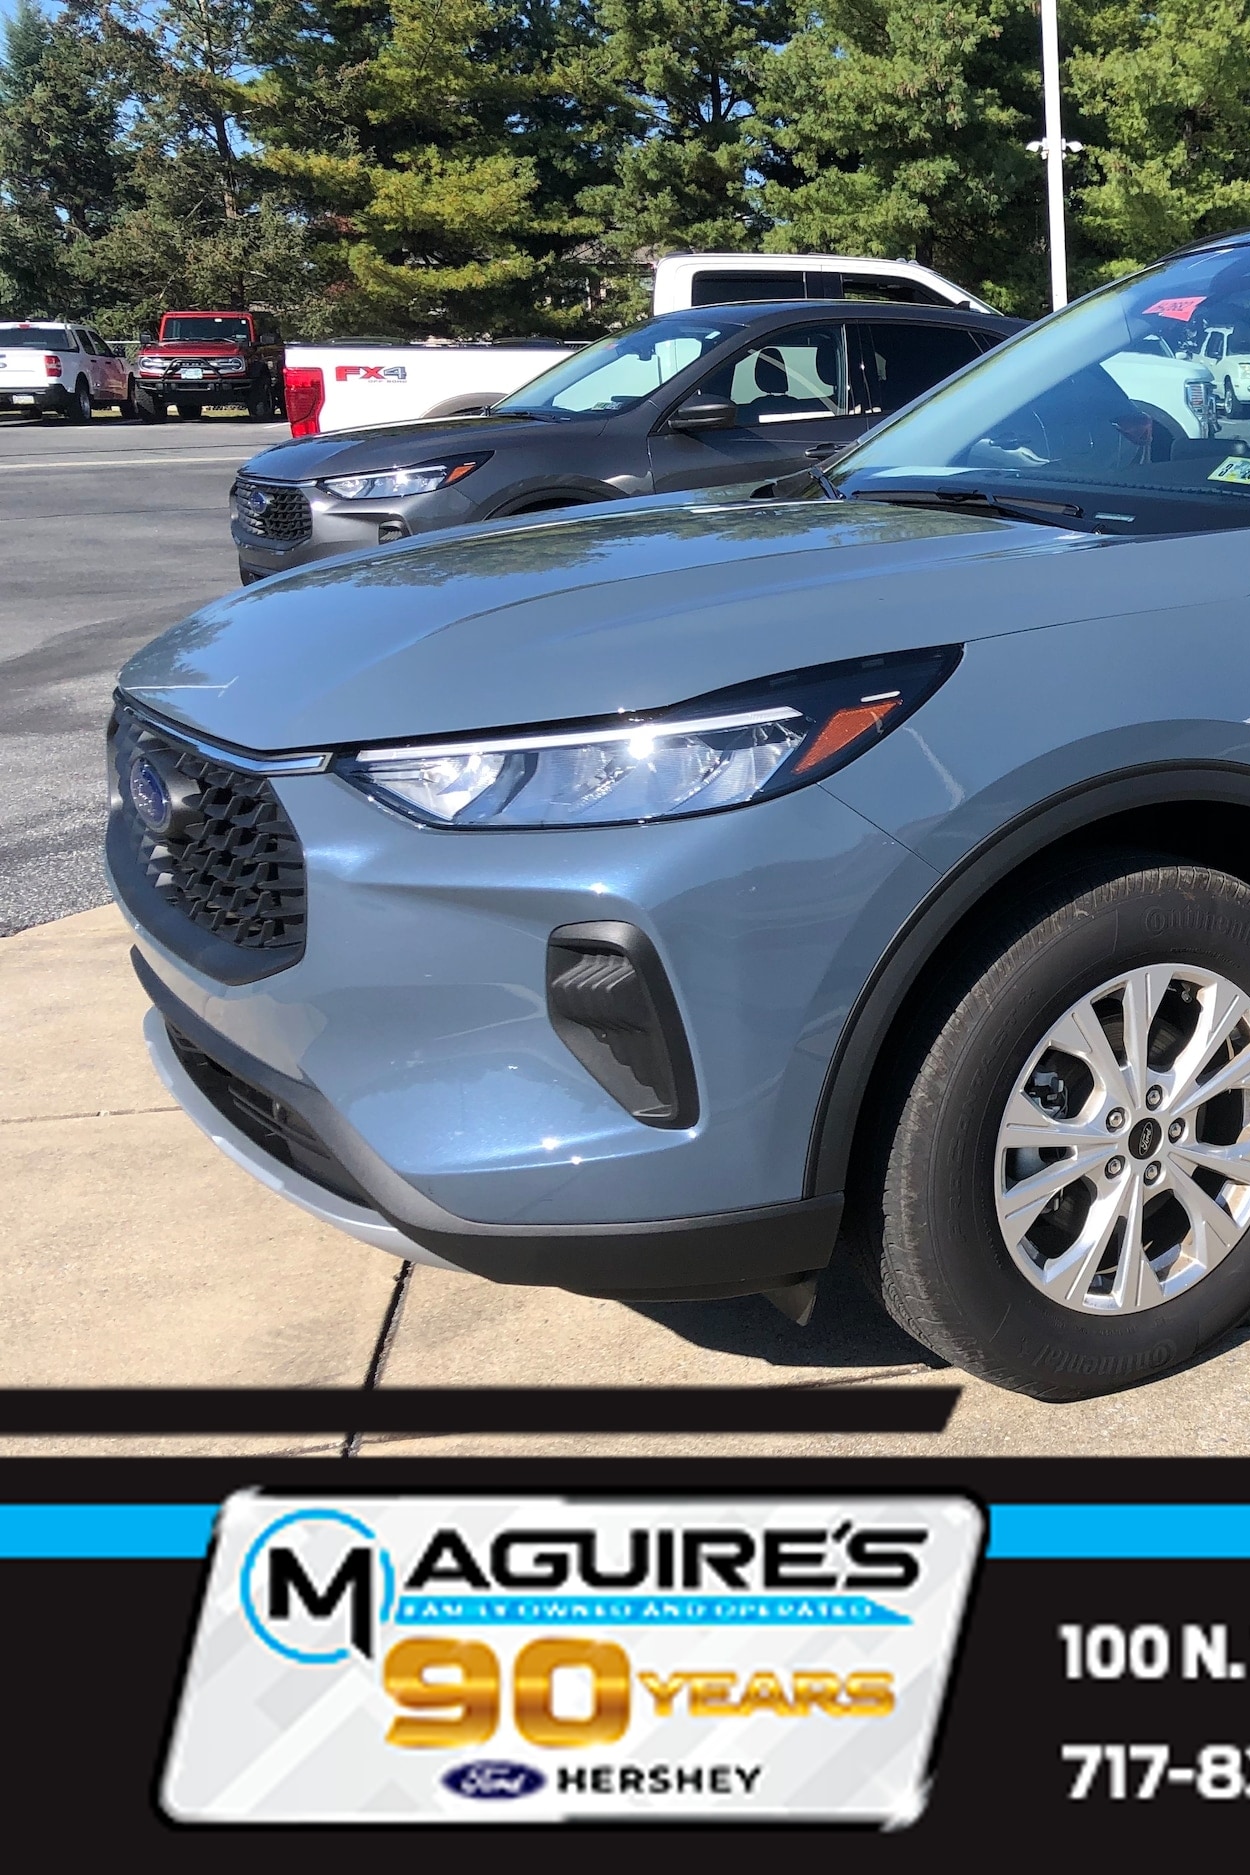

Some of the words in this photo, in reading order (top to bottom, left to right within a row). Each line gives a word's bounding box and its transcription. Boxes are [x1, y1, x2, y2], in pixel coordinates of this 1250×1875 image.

[335, 365, 407, 381] FX4
[1218, 463, 1234, 476] 3
[1032, 1338, 1177, 1376] Continental
